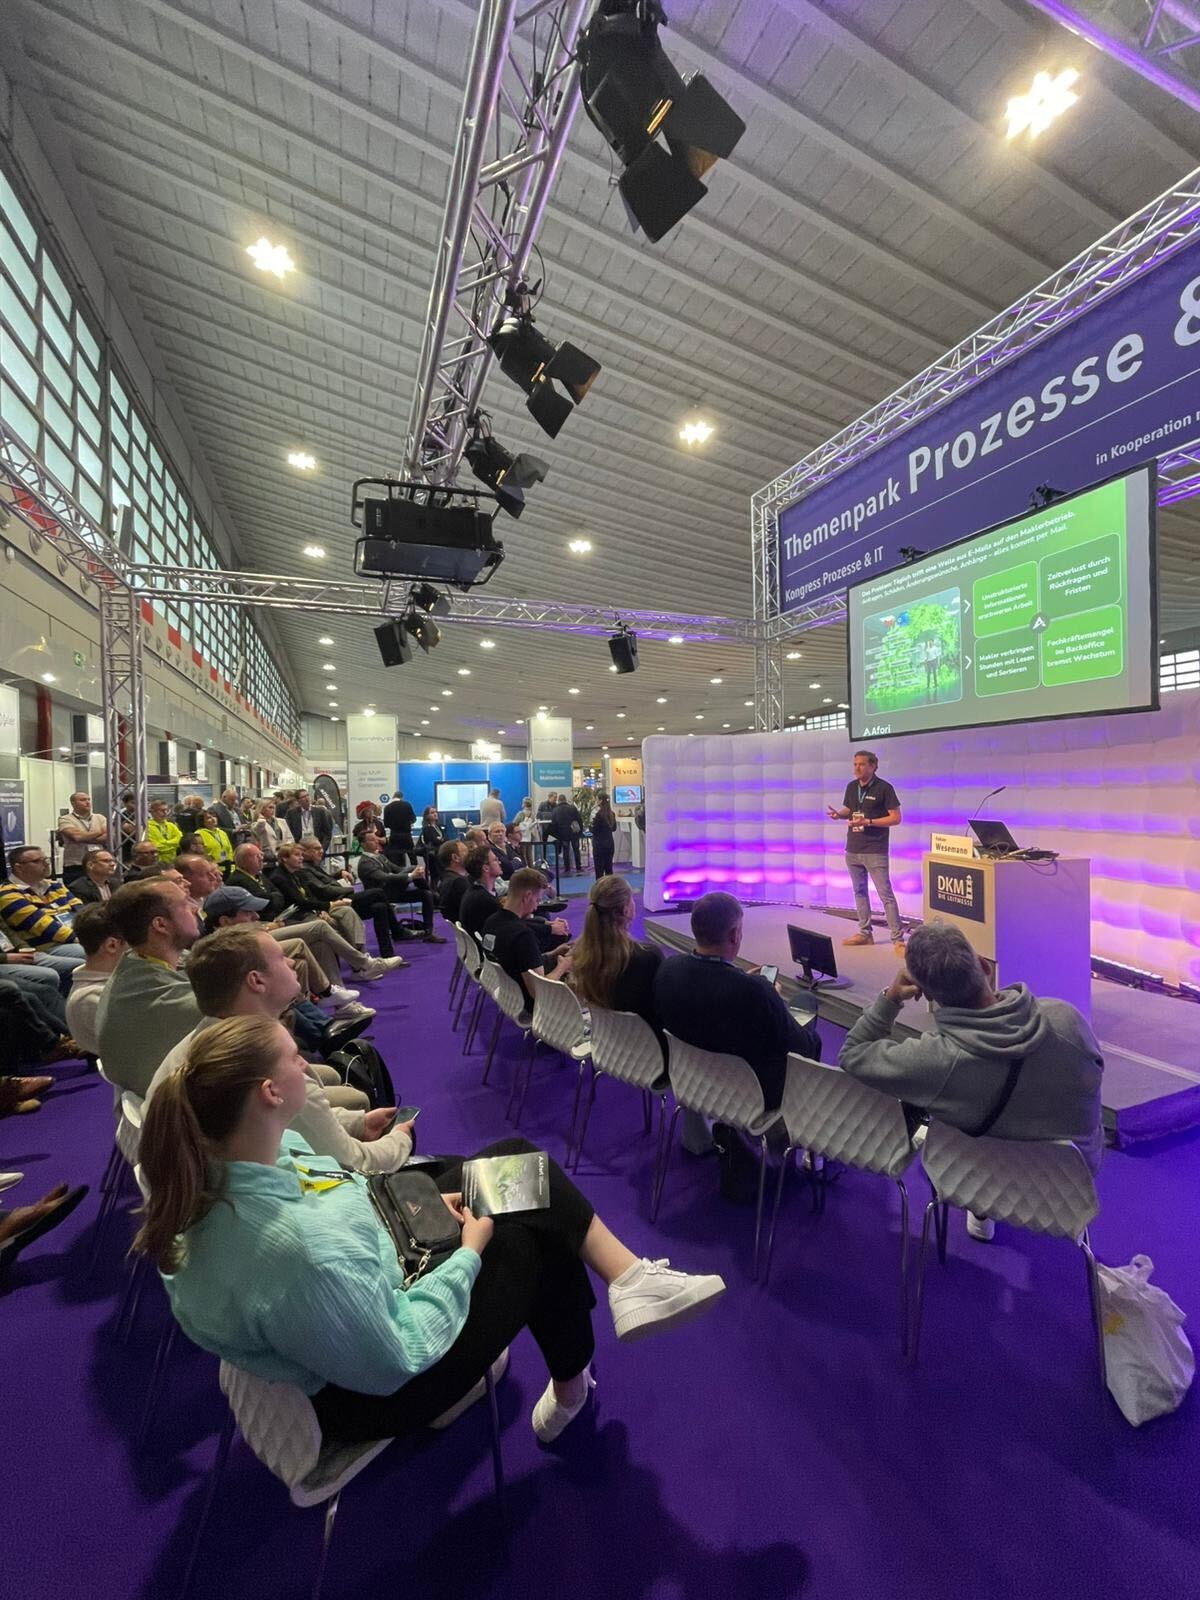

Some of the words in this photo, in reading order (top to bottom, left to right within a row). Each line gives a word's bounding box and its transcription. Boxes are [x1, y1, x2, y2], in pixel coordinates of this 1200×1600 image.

[784, 478, 900, 560] Themenpark
[908, 334, 1144, 494] Prozesse
[1173, 276, 1200, 346] &
[1096, 453, 1107, 465] in
[1111, 413, 1192, 459] Kooperation
[1005, 533, 1019, 543] den
[785, 578, 821, 603] Kongress
[822, 560, 862, 586] Prozesse
[864, 552, 872, 567] &
[874, 545, 884, 563] IT
[1048, 564, 1086, 580] Zeitverlust
[1087, 556, 1111, 568] durch
[1049, 574, 1091, 590] Rückfragen
[1092, 567, 1108, 577] und
[1065, 585, 1091, 596] Fristen
[871, 724, 891, 736] Afori
[935, 843, 968, 855] Wesemann
[937, 875, 964, 895] DKM
